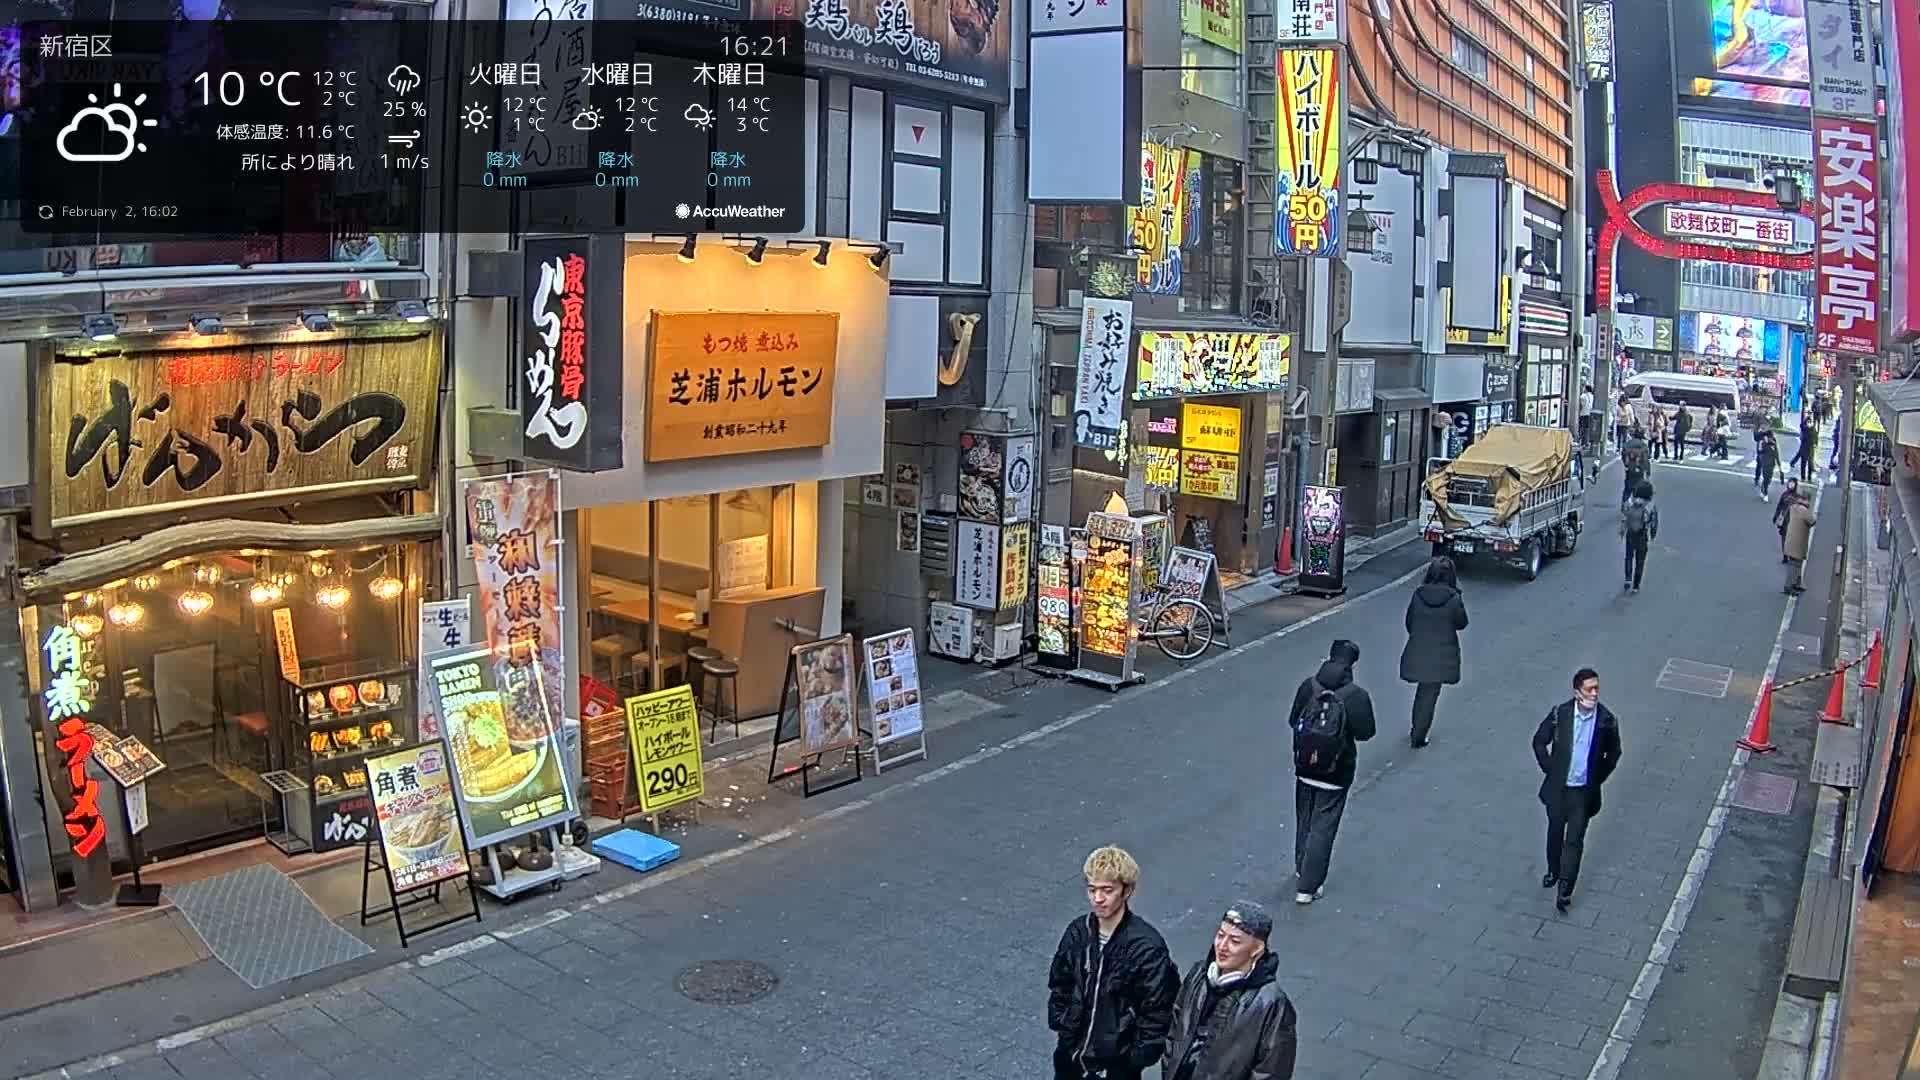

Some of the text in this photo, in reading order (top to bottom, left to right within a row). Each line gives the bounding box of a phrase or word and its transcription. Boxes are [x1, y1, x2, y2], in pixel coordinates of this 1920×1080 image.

[1832, 97, 1857, 112] 3F
[1295, 54, 1322, 190] ハイボール
[1161, 150, 1176, 287] ハイボール
[1670, 211, 1789, 242] 歌舞伎町一番街
[1819, 126, 1876, 329] 安楽亭
[560, 253, 585, 400] 東京豚骨
[1818, 333, 1837, 347] 2F
[703, 331, 800, 354] もつ焼 煮込み
[1096, 309, 1125, 415] お好み焼き
[669, 366, 823, 406] 芝浦ホルモン
[1093, 433, 1117, 448] B1F
[972, 527, 984, 601] 芝浦ホルモン
[1040, 598, 1068, 614] 980
[435, 664, 480, 684] TOKYO
[439, 677, 482, 696] RAMEN
[644, 727, 691, 748] ハイボール
[645, 742, 692, 761] レモンサワー
[375, 764, 420, 797] 角煮
